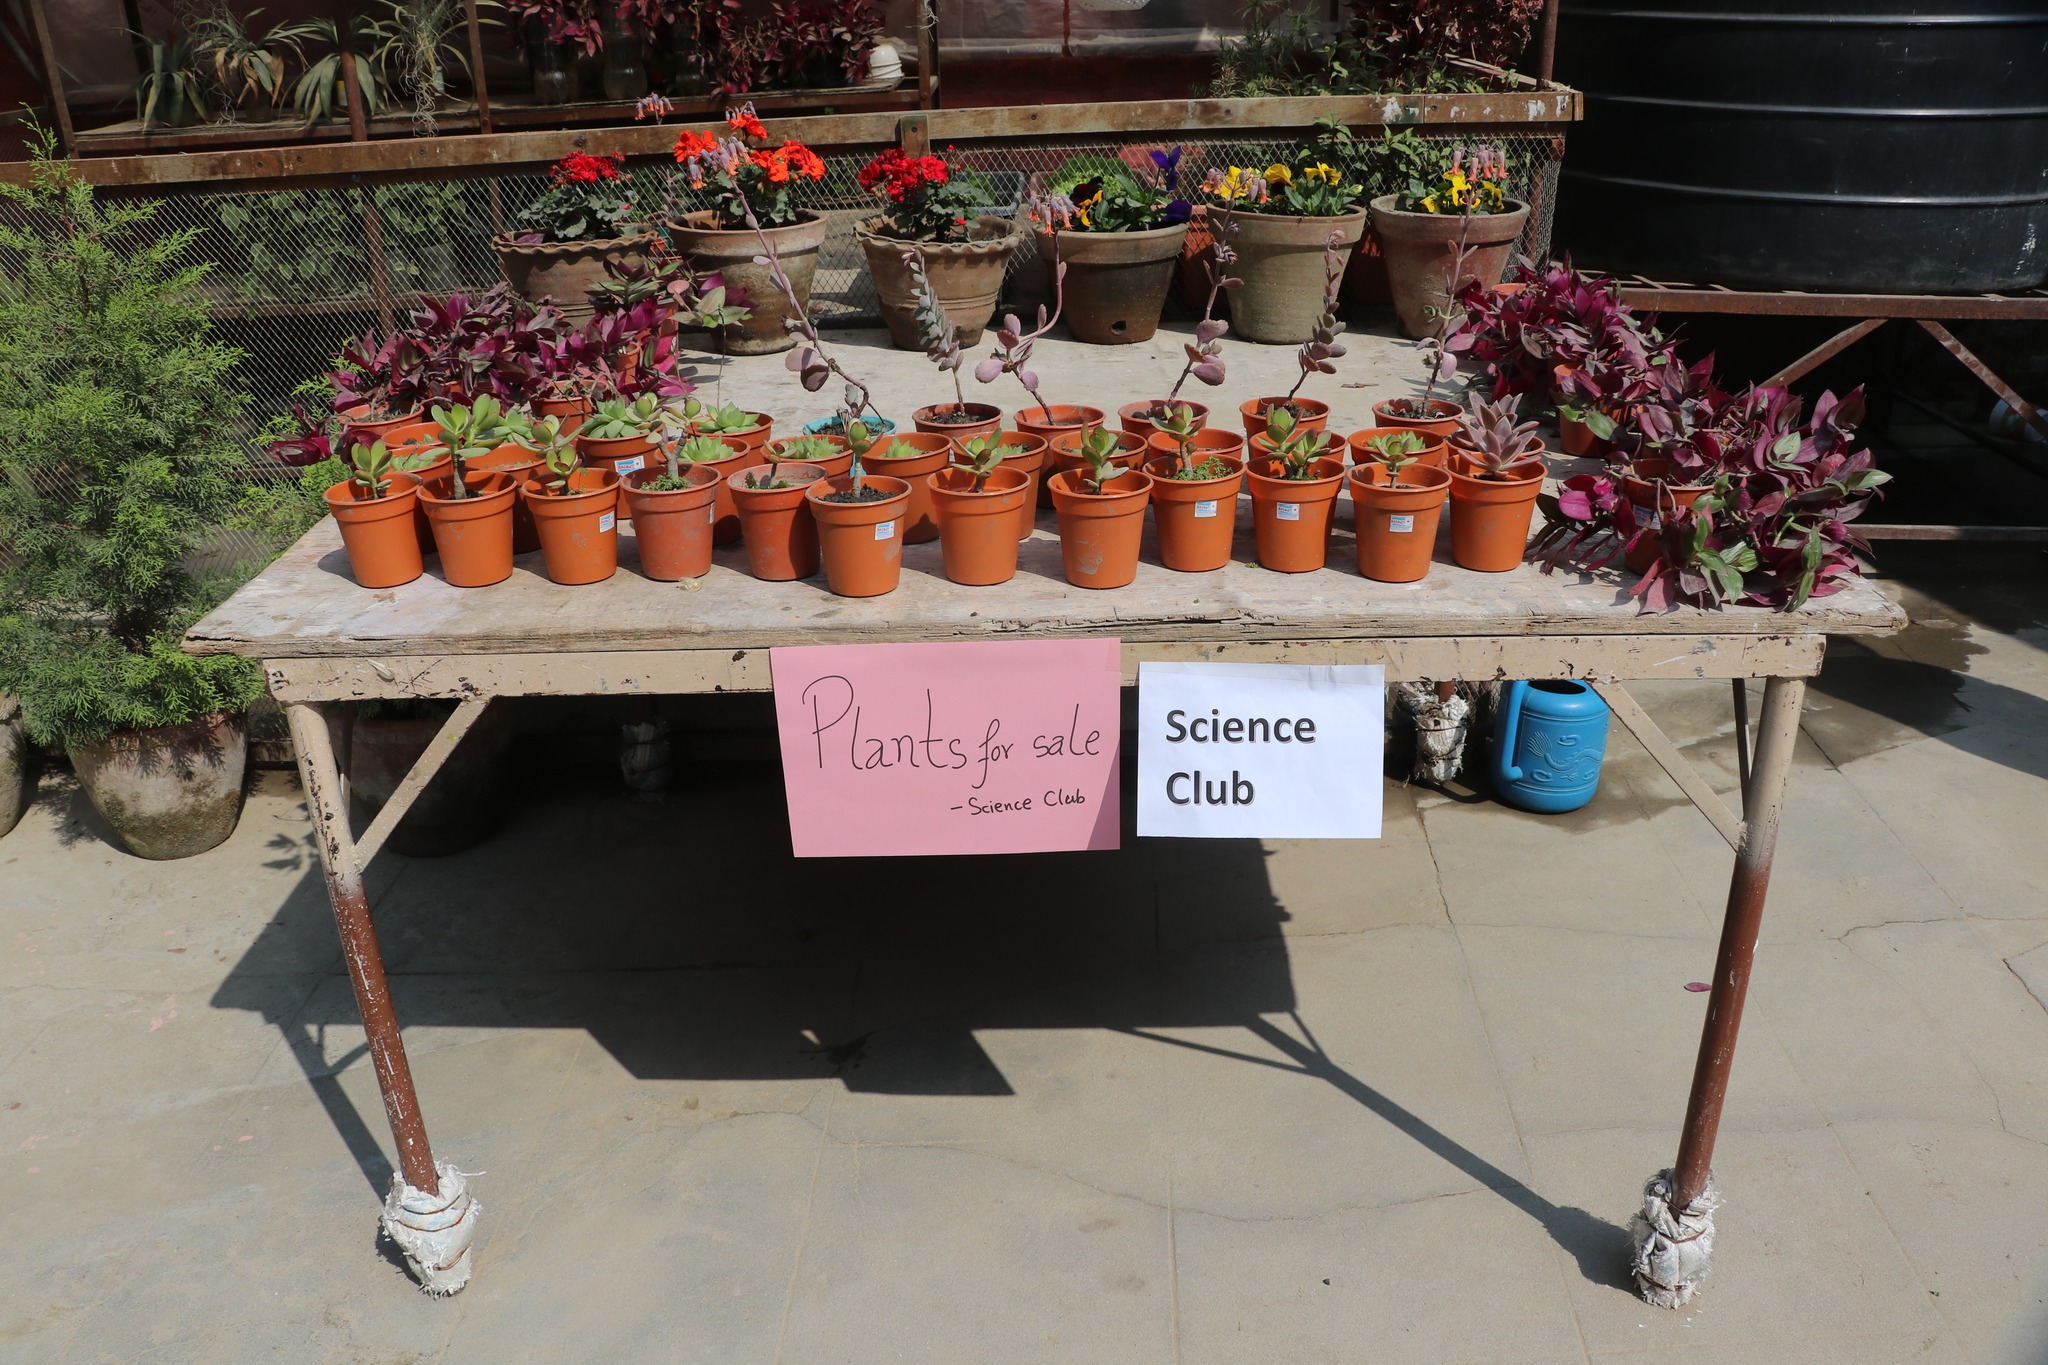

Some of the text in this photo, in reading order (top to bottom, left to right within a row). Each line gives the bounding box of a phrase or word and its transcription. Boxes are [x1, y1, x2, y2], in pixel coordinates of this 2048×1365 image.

[801, 675, 1101, 790] Plants for sale
[1165, 708, 1317, 744] Science
[1043, 788, 1086, 807] Club
[1166, 770, 1256, 806] Club
